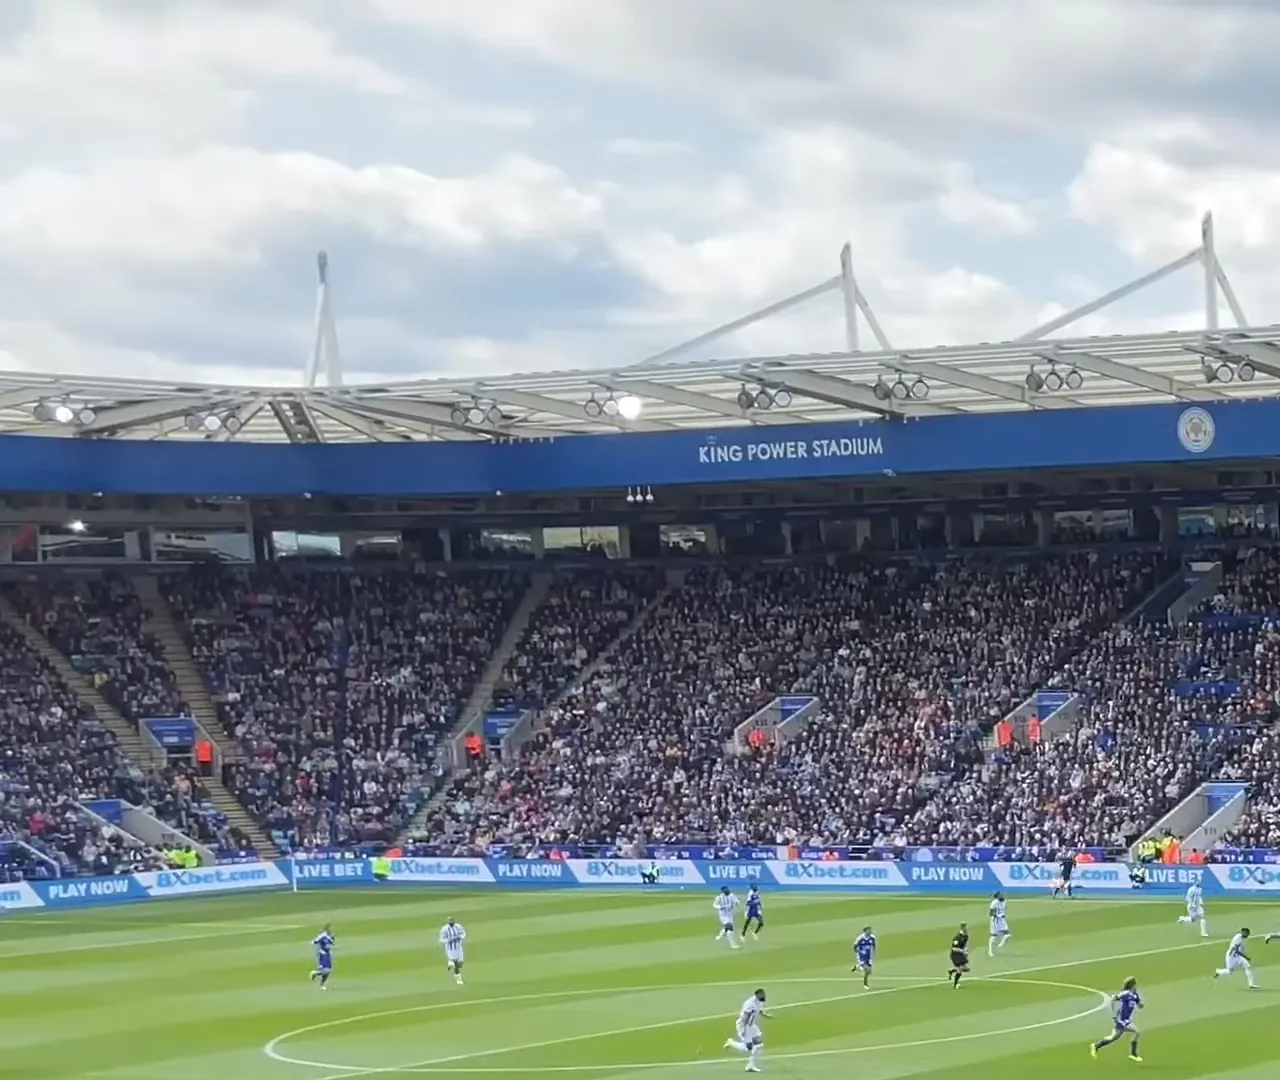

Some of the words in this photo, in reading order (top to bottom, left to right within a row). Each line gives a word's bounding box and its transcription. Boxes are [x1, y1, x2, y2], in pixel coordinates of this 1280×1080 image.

[699, 446, 742, 463] KING
[748, 441, 808, 461] POWER
[813, 437, 883, 457] STADIUM
[156, 867, 268, 888] 8Xbet.com
[295, 863, 330, 879] LIVE
[335, 864, 364, 878] BET
[498, 864, 529, 878] PLAY
[531, 864, 562, 878] NOW
[709, 865, 736, 879] LIVE
[785, 862, 888, 880] 8Xbet.com
[912, 867, 947, 881] PLAY
[949, 867, 984, 881] NOW
[1145, 869, 1175, 883] LIVE
[1178, 869, 1204, 883] BET
[49, 884, 86, 899] PLAY
[90, 879, 128, 895] NOW
